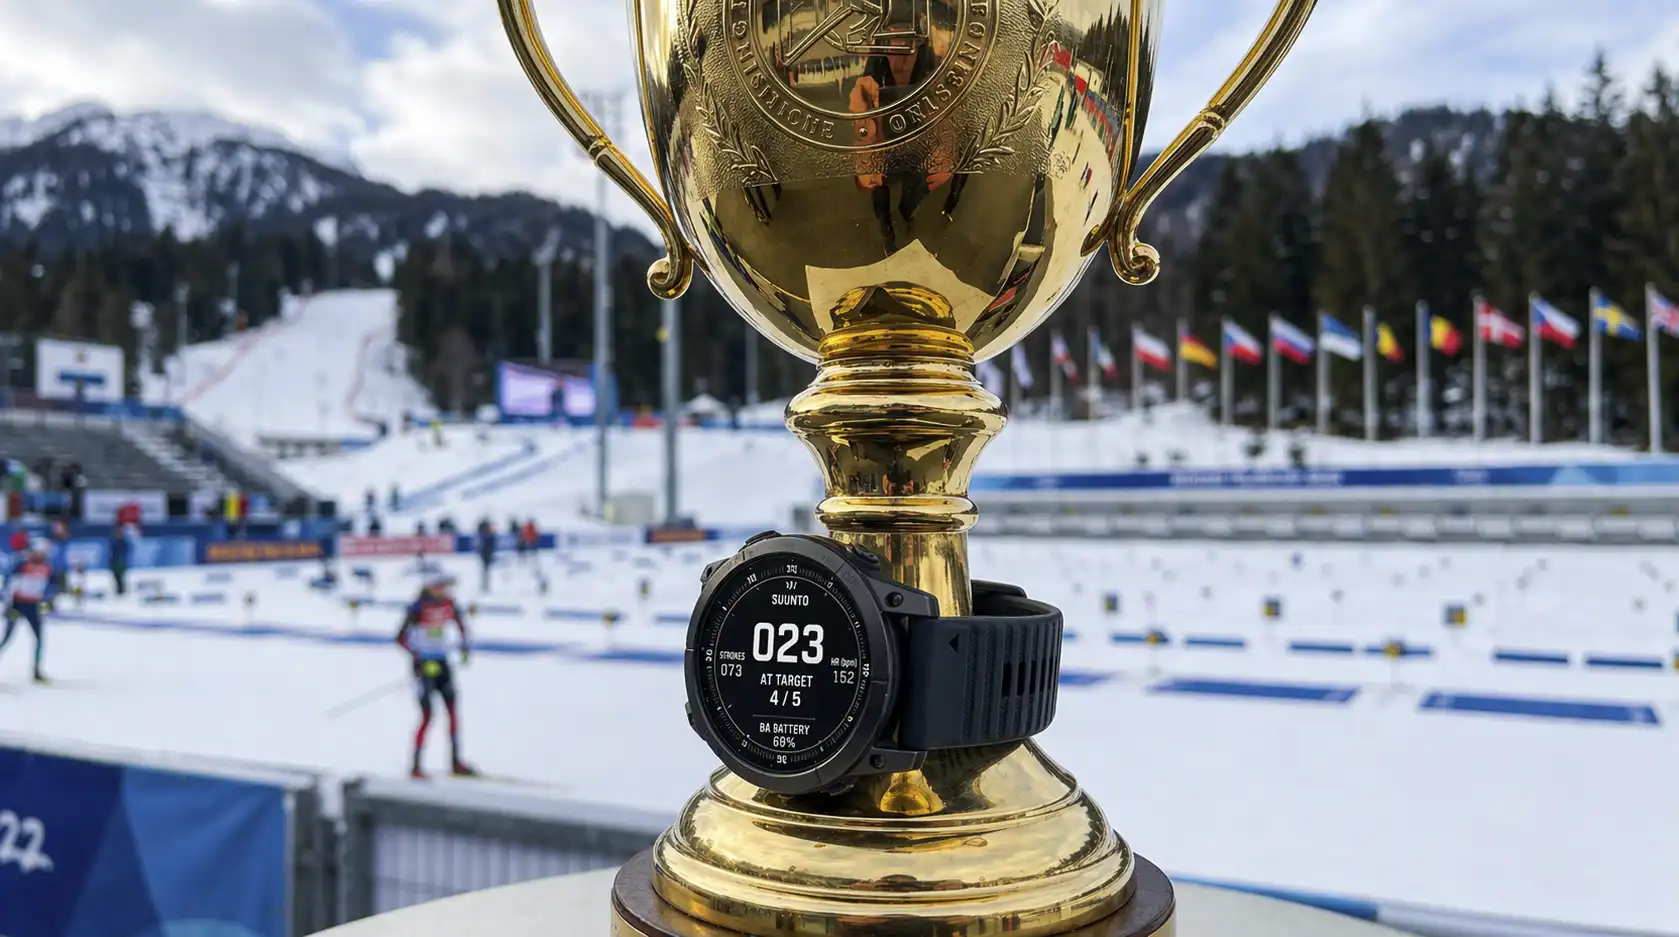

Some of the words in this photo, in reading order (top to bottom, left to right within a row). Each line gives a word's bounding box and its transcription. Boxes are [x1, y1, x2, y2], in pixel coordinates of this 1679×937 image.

[771, 594, 809, 607] SUUNTO
[752, 622, 824, 665] 023
[720, 663, 743, 678] 073
[760, 673, 773, 686] AT
[775, 673, 814, 688] TARGET
[759, 722, 771, 734] BA
[773, 722, 811, 736] BATTERY
